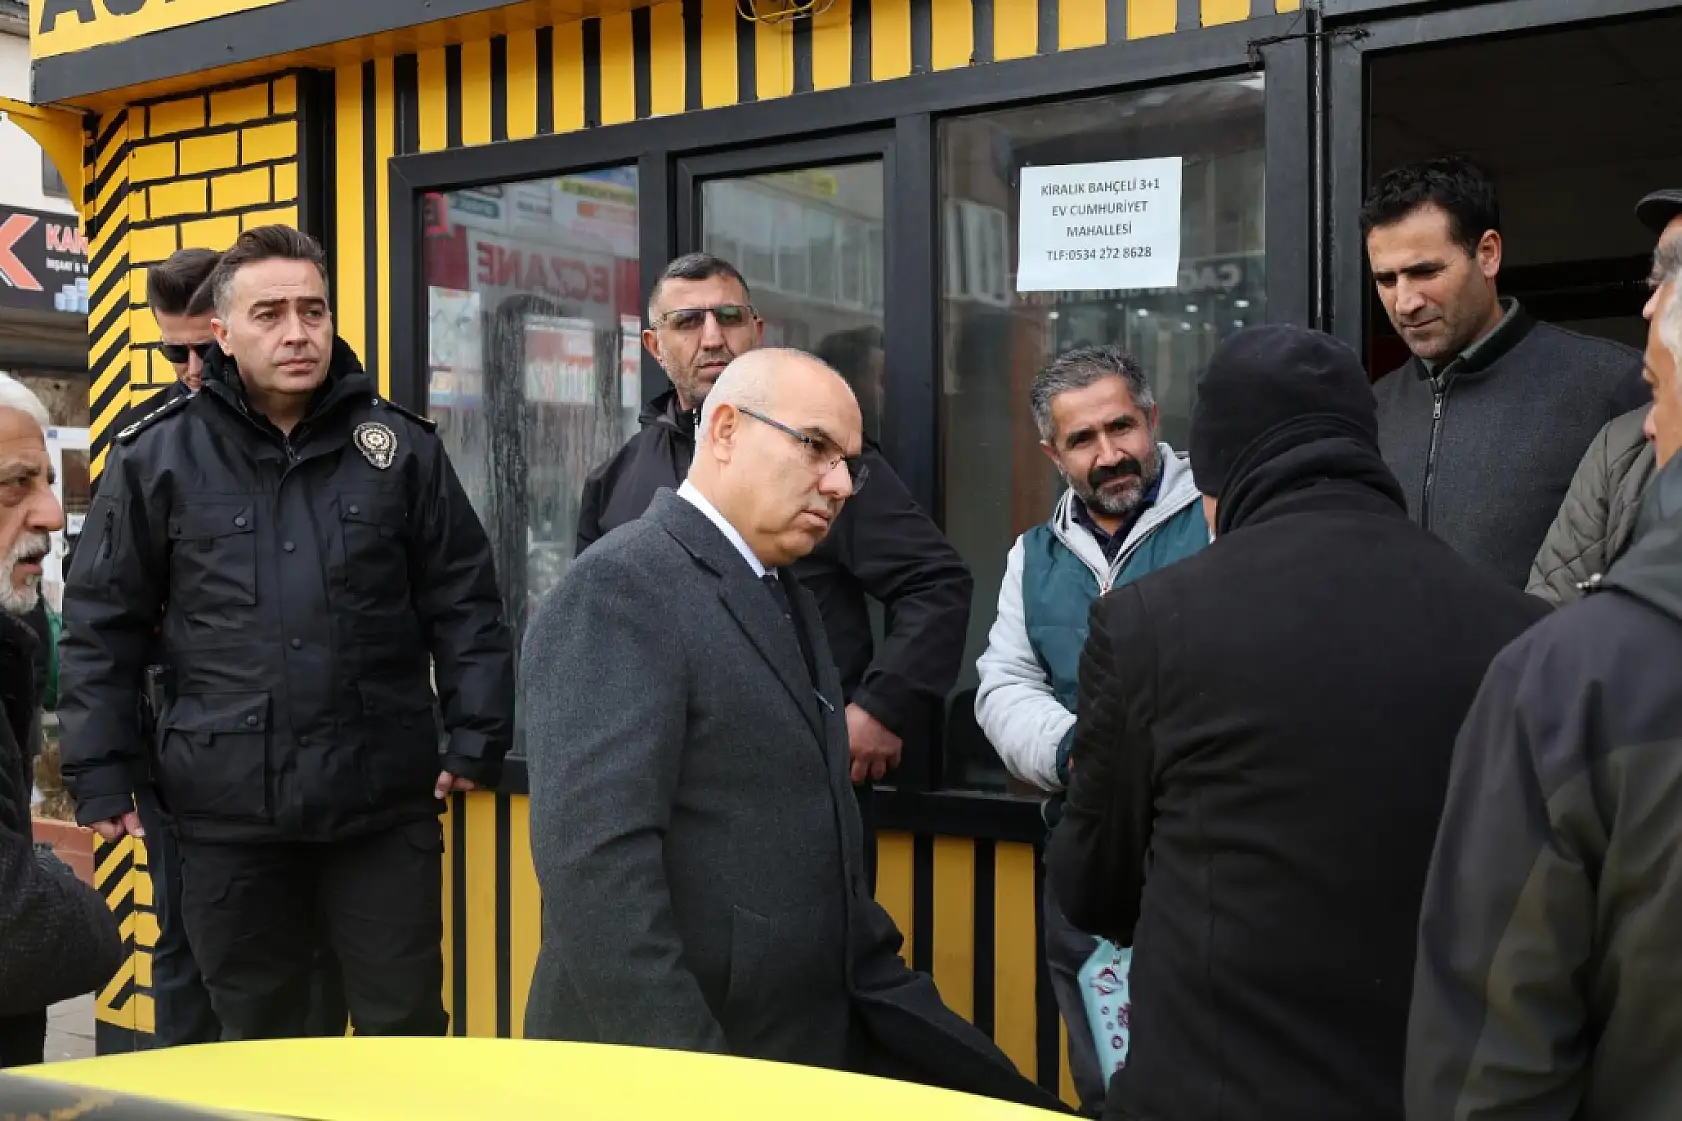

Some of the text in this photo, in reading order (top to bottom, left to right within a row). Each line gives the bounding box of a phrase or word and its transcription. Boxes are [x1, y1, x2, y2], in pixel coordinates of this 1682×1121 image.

[1040, 177, 1160, 196] KİRALIK BAHÇELİ 3+1
[1052, 199, 1149, 217] EV CUMHURİYET
[1066, 221, 1132, 238] MAHALLESİ
[1047, 245, 1152, 261] TLF:0534 272 8628
